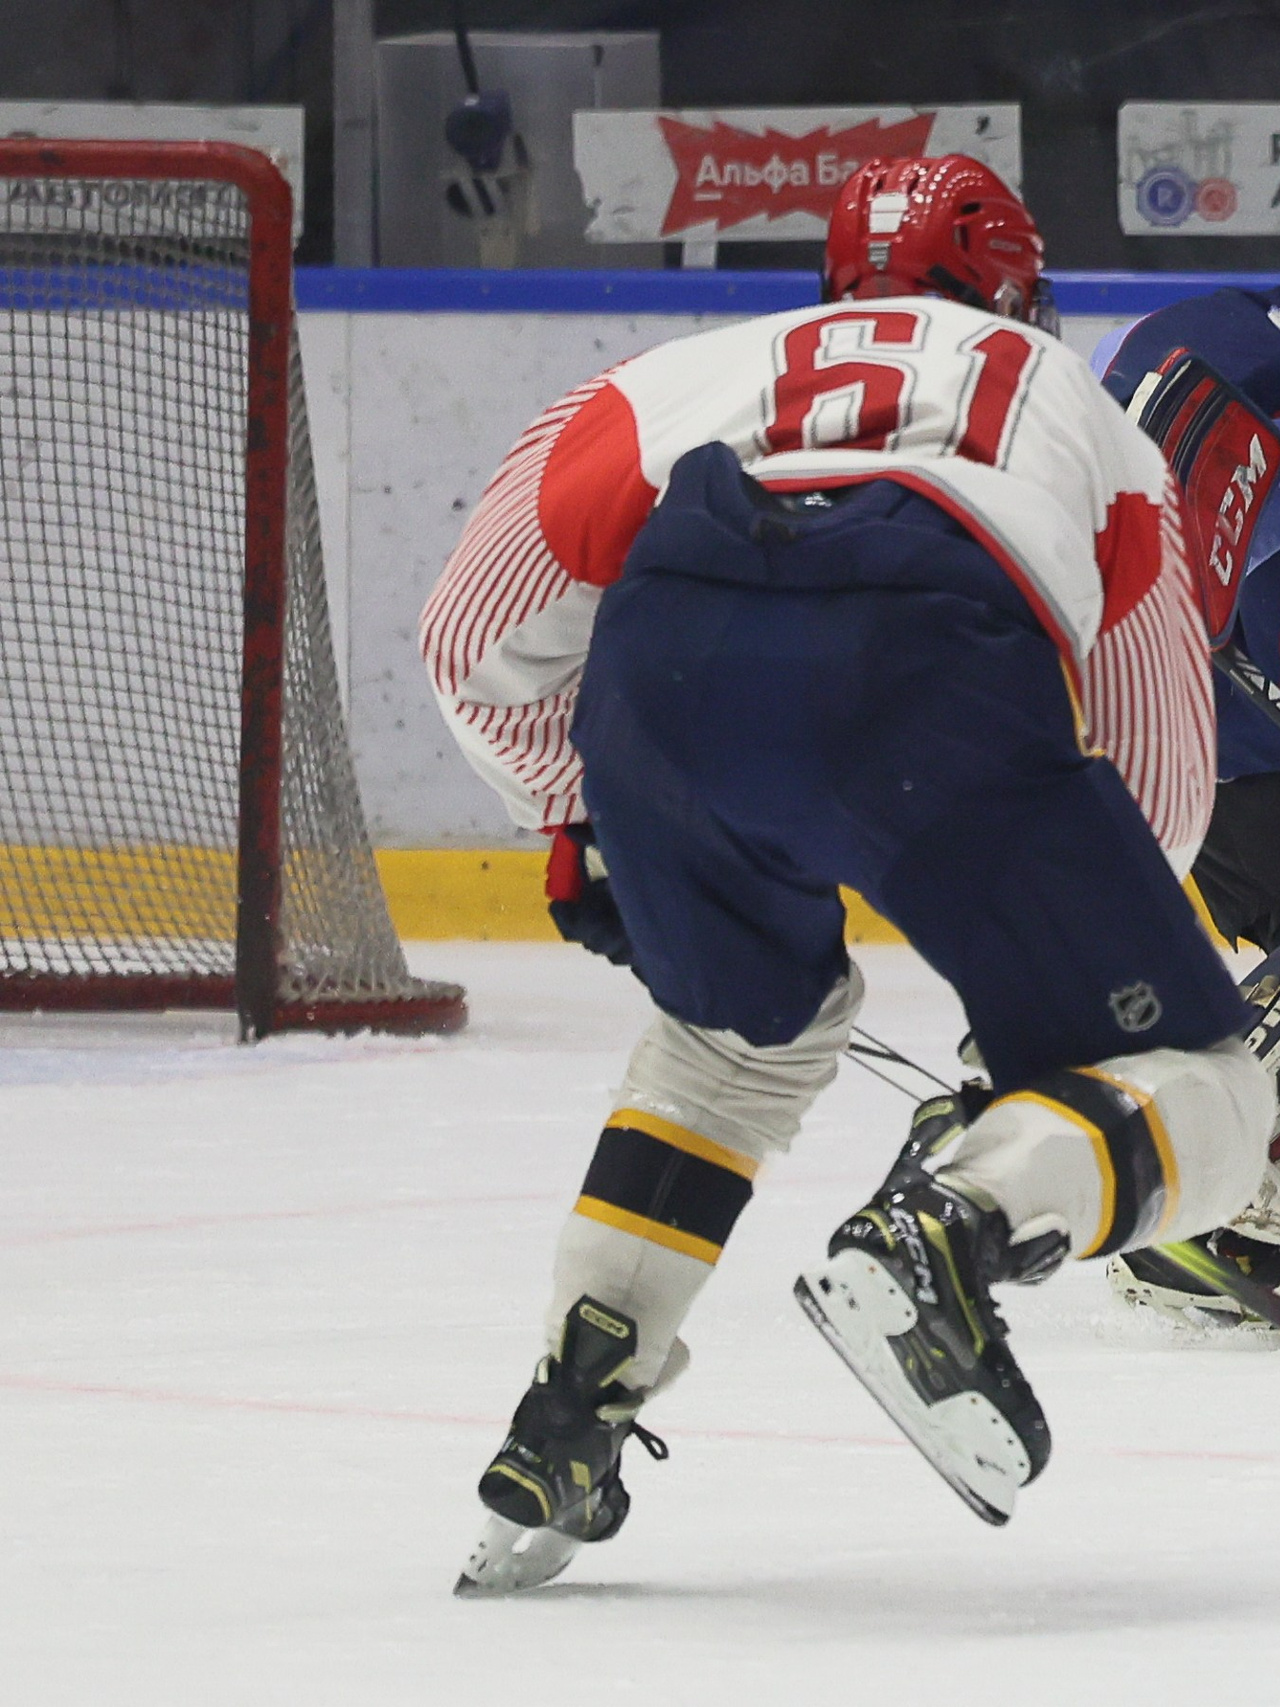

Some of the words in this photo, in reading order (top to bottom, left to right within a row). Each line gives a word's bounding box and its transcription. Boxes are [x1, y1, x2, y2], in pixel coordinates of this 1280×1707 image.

[697, 154, 810, 195] Альфа
[758, 308, 1046, 471] 61
[1208, 433, 1268, 587] CCM
